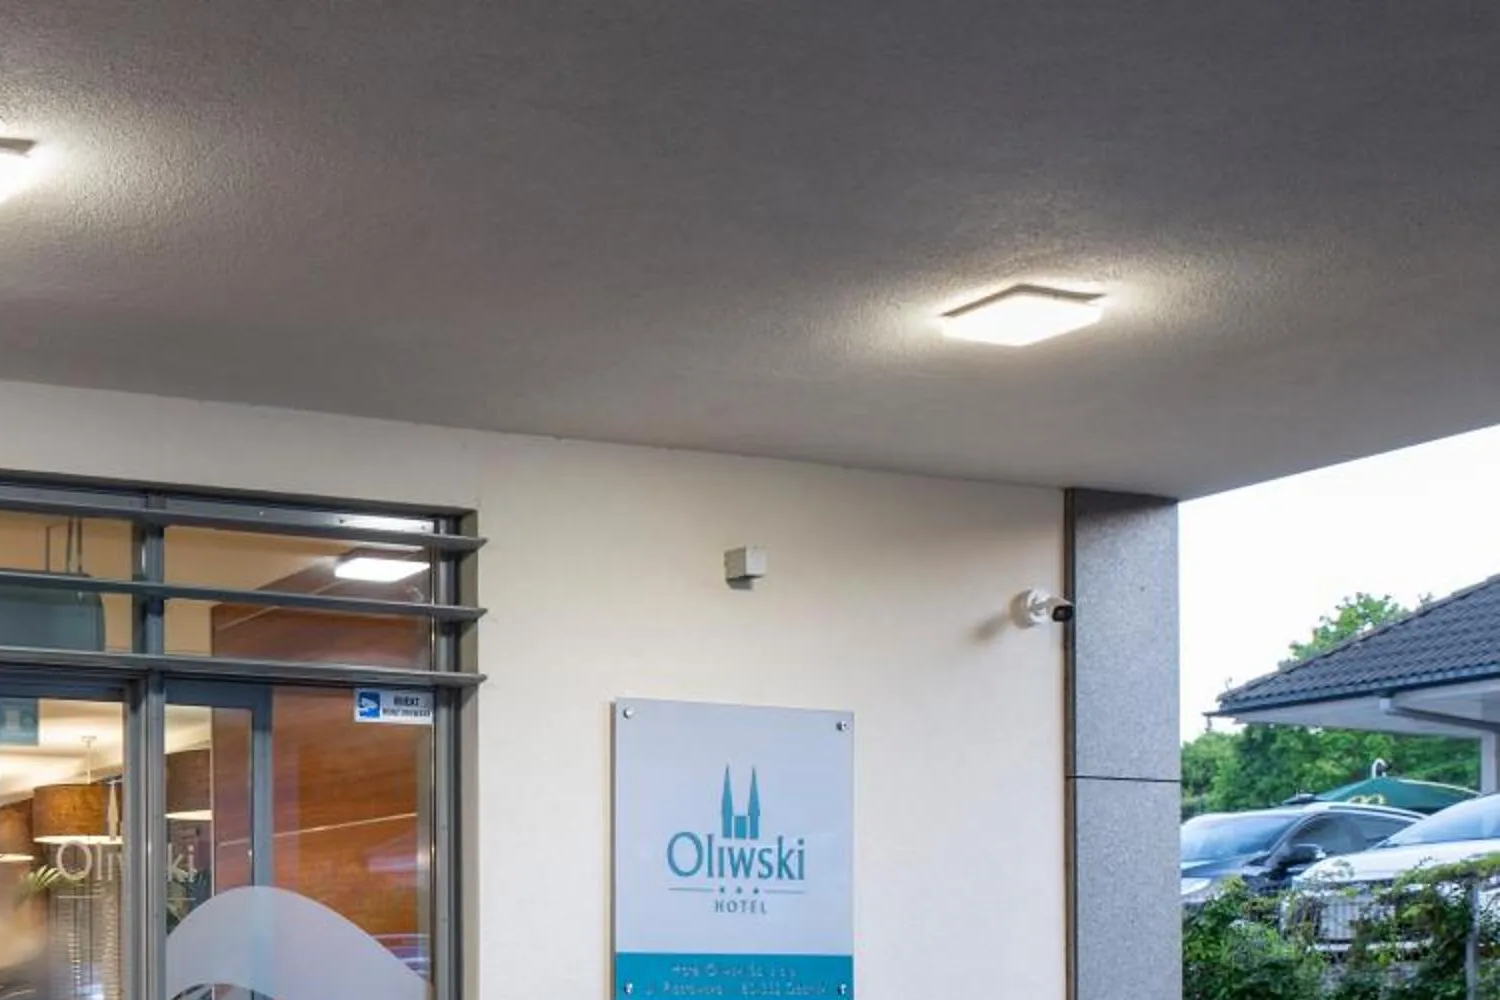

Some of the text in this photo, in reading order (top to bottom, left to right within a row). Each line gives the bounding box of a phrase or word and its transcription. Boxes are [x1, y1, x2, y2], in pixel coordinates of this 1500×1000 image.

[56, 840, 197, 882] Oliki
[667, 831, 805, 880] Oliwski
[714, 899, 768, 914] HOTEL
